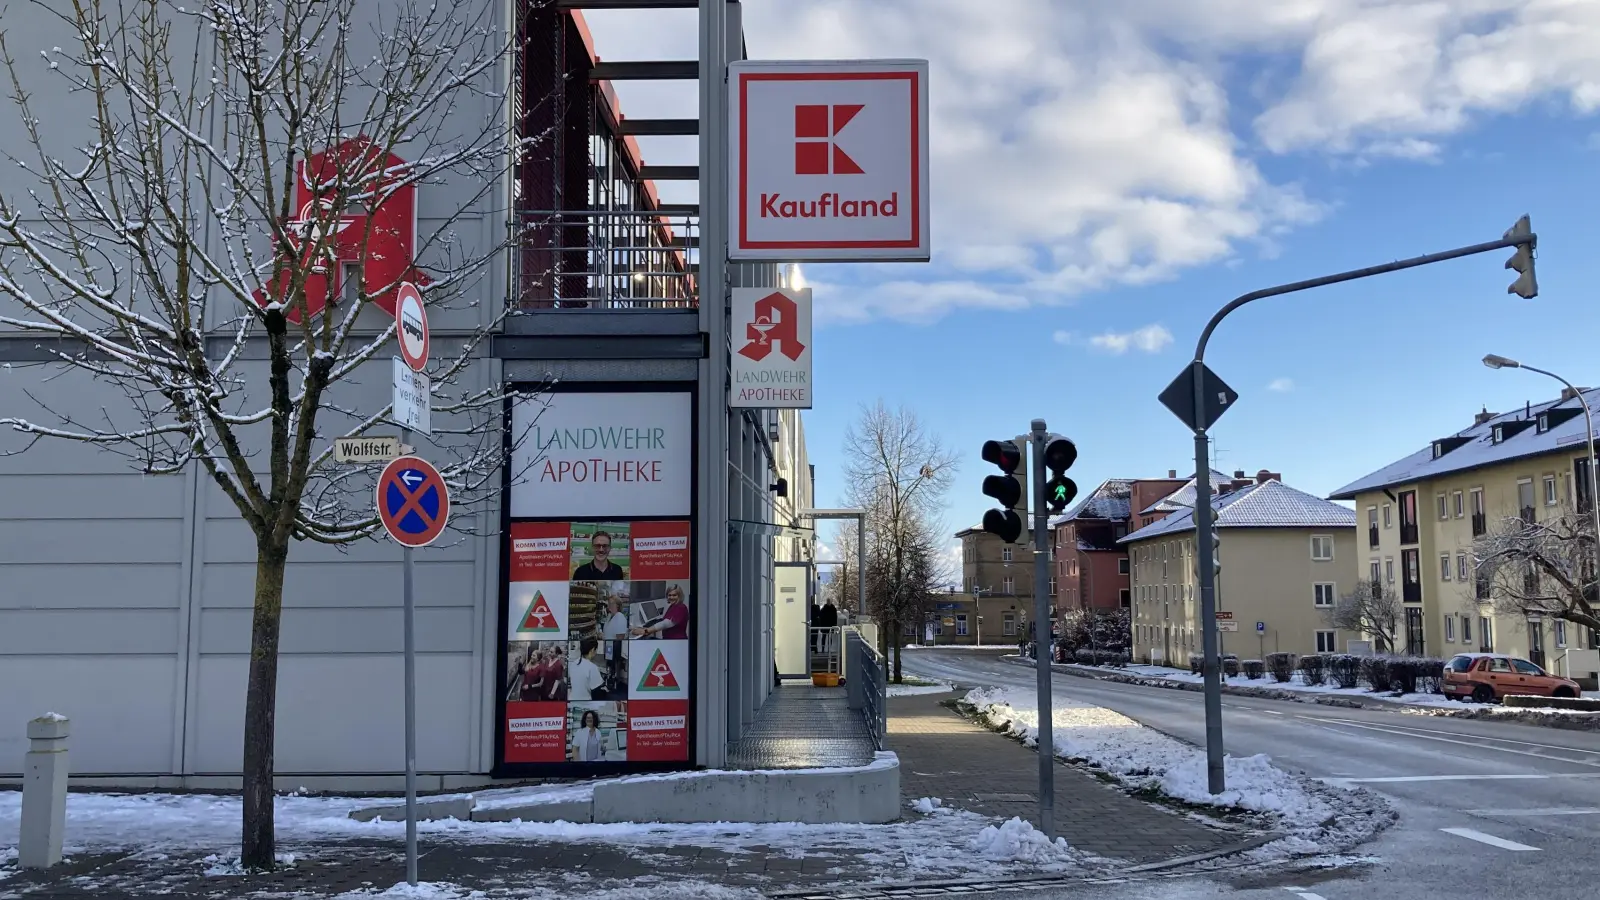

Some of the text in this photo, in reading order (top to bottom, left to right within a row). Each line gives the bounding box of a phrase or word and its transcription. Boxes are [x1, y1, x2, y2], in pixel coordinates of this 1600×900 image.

[760, 192, 898, 218] Kaufland
[399, 388, 427, 410] verkehr
[738, 387, 804, 401] APOTHEKE
[408, 406, 421, 424] frei
[341, 441, 392, 457] Wolffstr.
[540, 458, 662, 482] APOTHEKE
